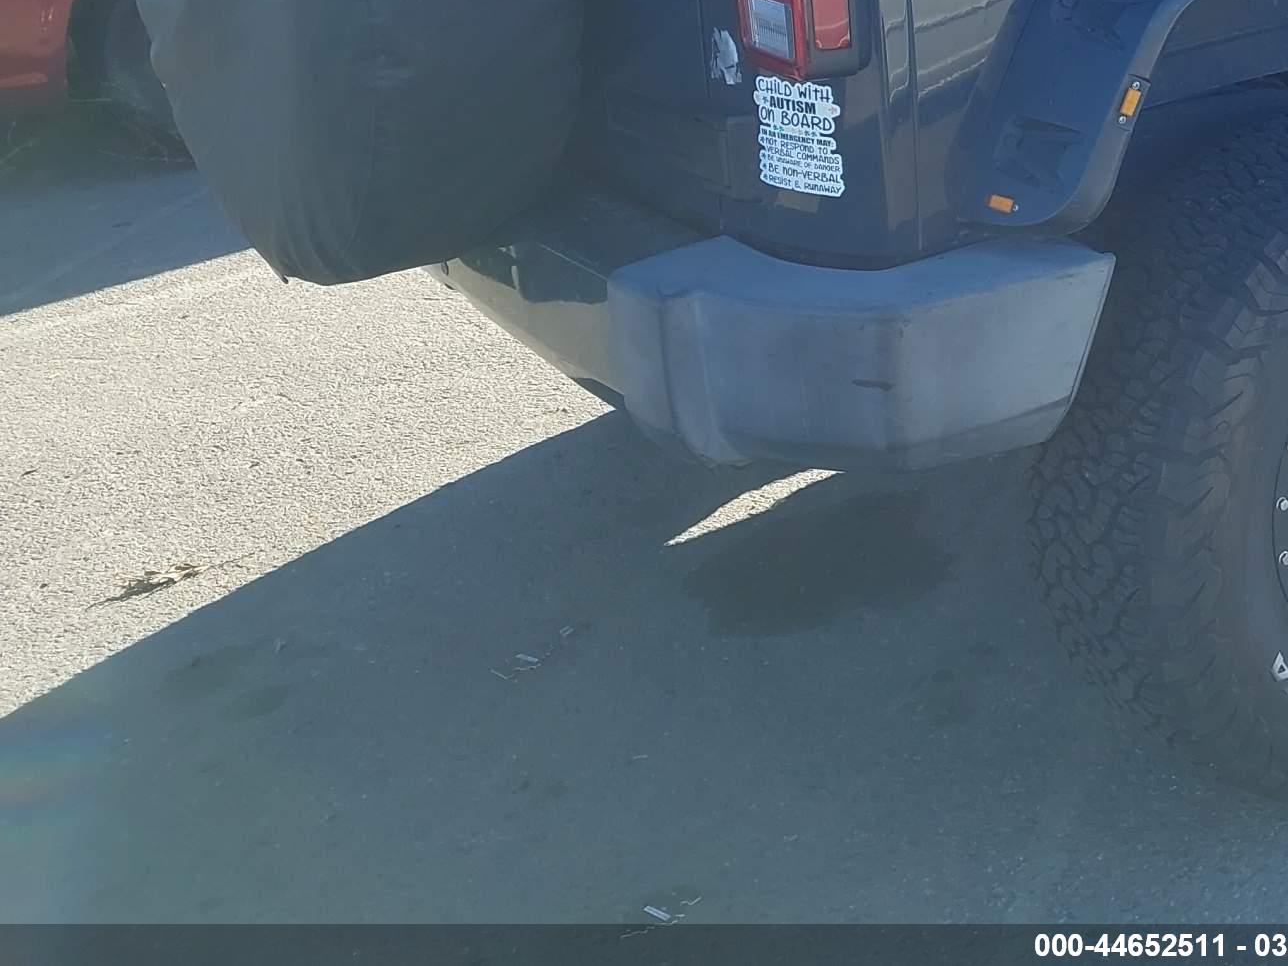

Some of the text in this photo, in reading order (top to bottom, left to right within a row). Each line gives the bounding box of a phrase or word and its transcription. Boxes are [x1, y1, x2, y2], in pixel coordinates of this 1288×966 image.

[770, 96, 816, 115] AUTISM
[781, 111, 832, 131] BOARD
[777, 132, 815, 145] EMERGENCY
[766, 146, 795, 158] VERBAL
[818, 147, 828, 155] TO
[767, 154, 775, 162] BE
[768, 163, 780, 174] BE
[794, 180, 801, 188] &
